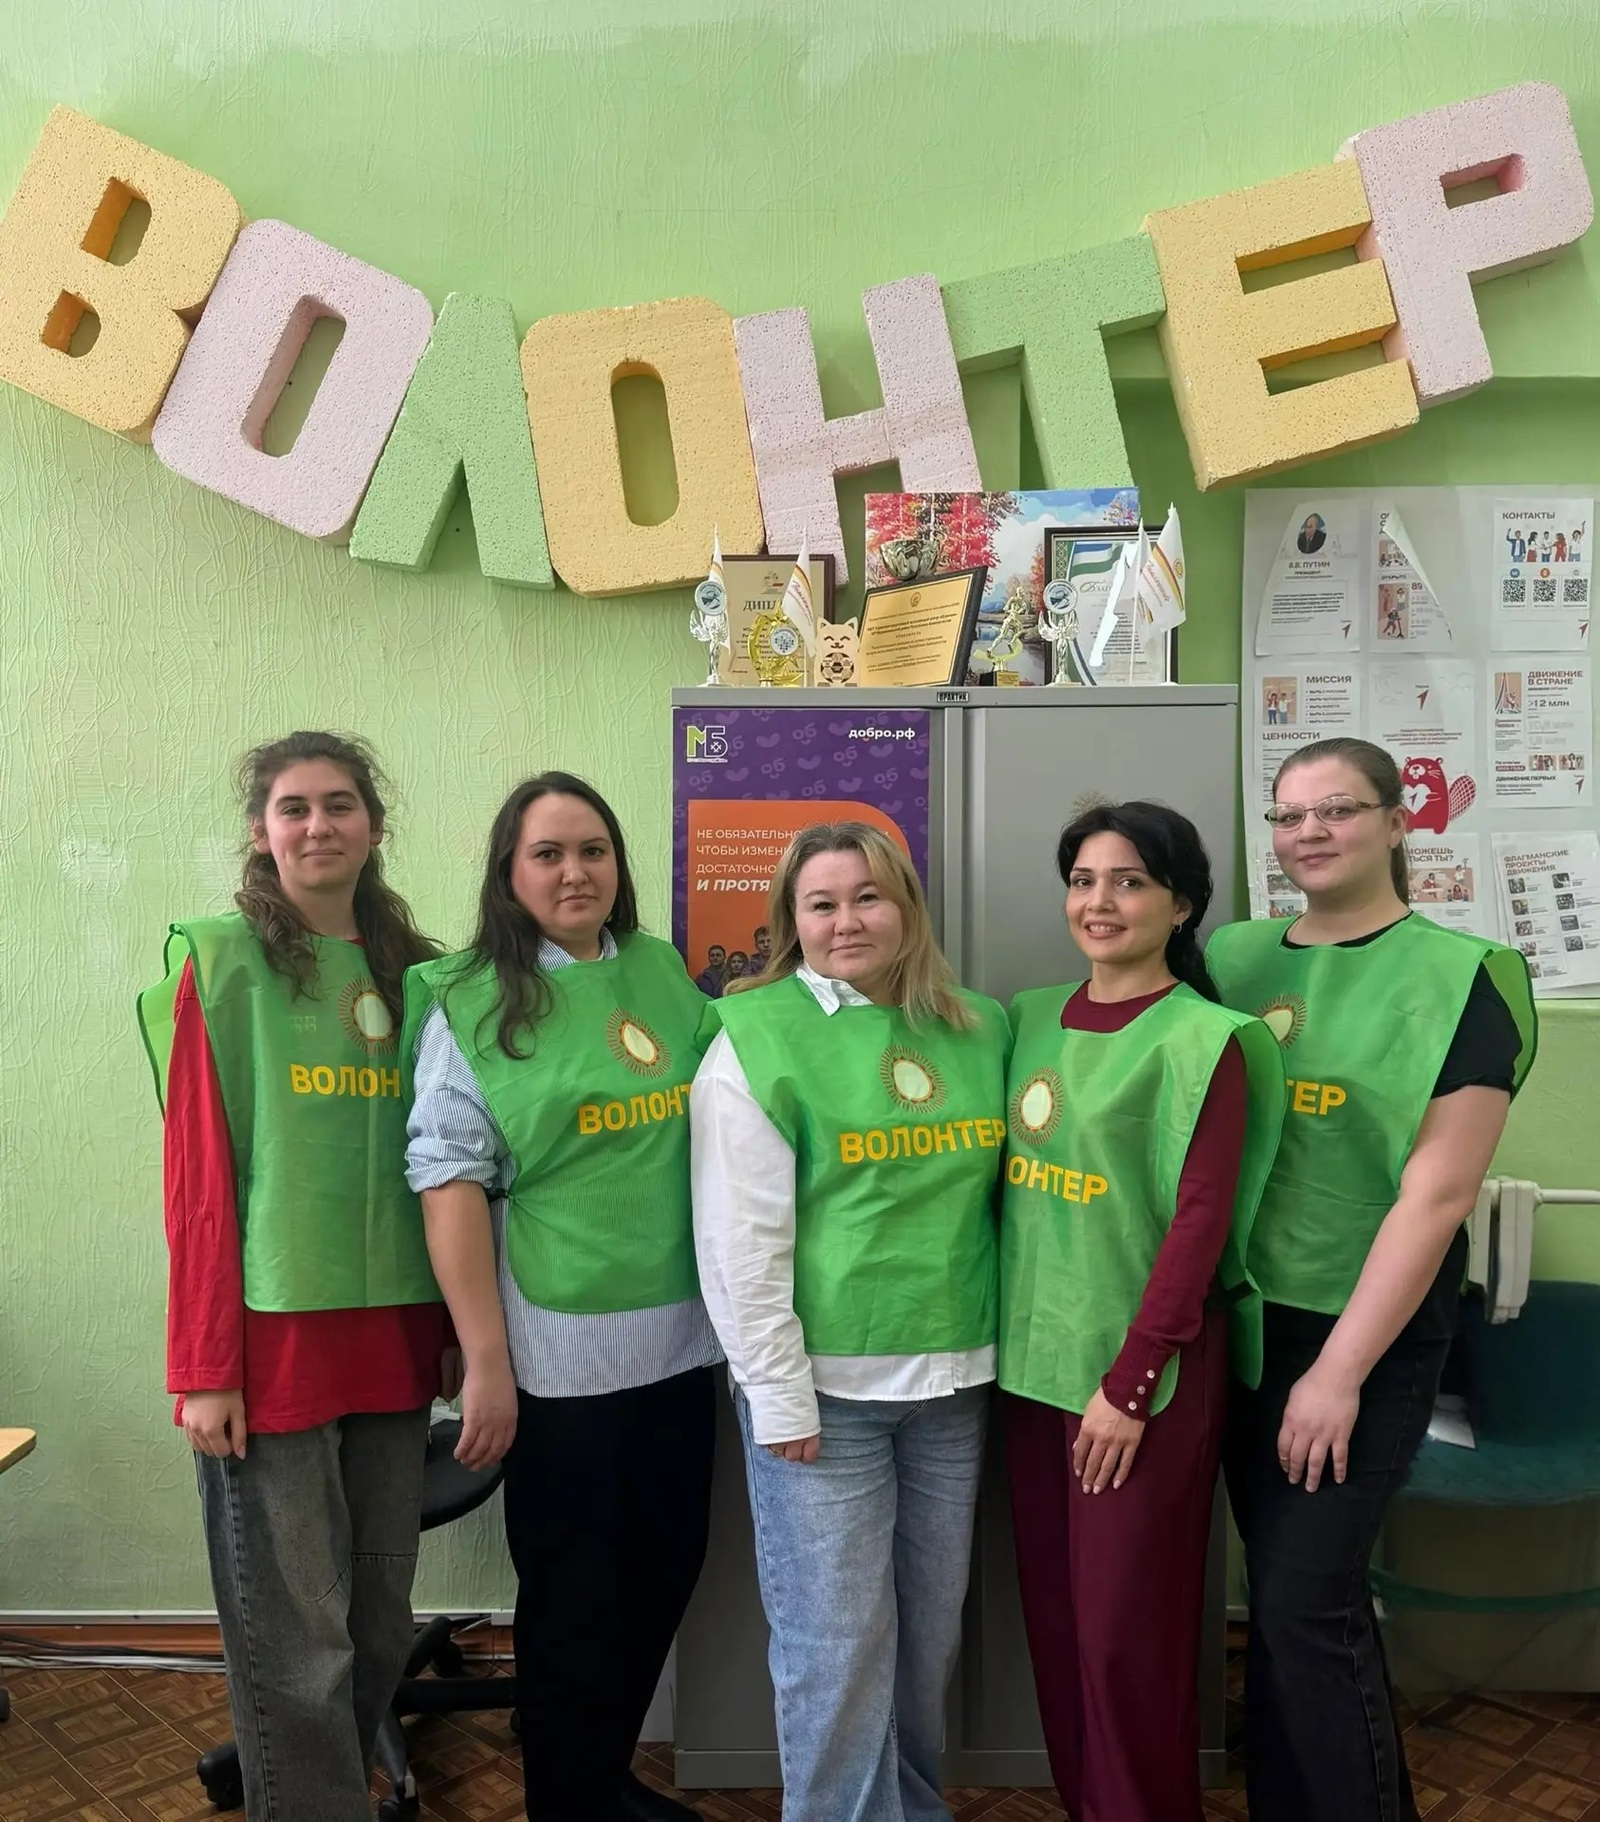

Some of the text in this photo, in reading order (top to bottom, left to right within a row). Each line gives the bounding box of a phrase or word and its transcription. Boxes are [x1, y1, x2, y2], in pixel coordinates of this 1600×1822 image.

[0, 81, 1594, 598] ВОЛОНТЕР
[1502, 512, 1556, 520] КОНТАКТЫ
[1306, 675, 1352, 683] МИССИЯ
[1528, 670, 1584, 679] ДВИЖЕНИЕ
[848, 727, 916, 741] добро.рф
[1262, 732, 1320, 741] ЦЕННОСТИ
[697, 829, 802, 839] НЕ ОБЯЗАТЕЛЬНО
[696, 846, 738, 855] ЧТОБЫ
[1504, 850, 1569, 862] ФЛАГМАНСКИЕ
[696, 864, 777, 874] ДОСТАТОЧНО
[1505, 860, 1546, 869] ПРОЕКТЫ
[1507, 865, 1556, 876] ДВИЖЕНИЯ
[697, 880, 771, 891] И ПРОТЯ
[290, 1063, 401, 1098] ВОЛОН
[1286, 1078, 1347, 1116] ЕР
[839, 1118, 1007, 1164] ВОЛОНТЕР
[1008, 1155, 1108, 1204] ОНТЕР
